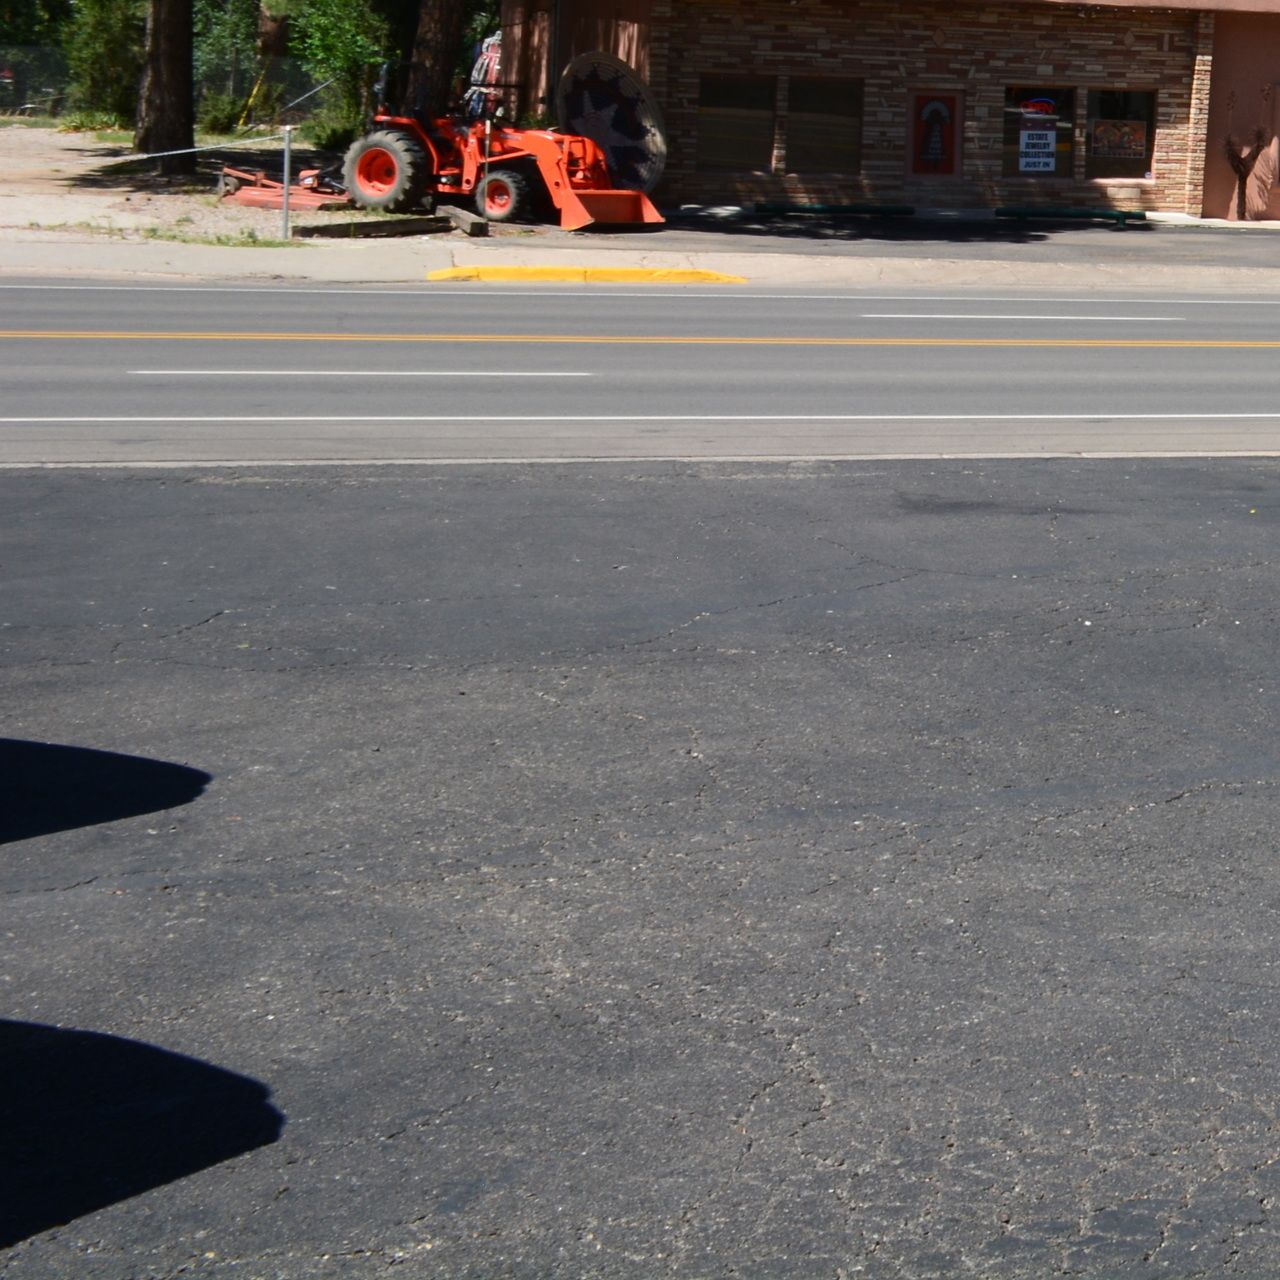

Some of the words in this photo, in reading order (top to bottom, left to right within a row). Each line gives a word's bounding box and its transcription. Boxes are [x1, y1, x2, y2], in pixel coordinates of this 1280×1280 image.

[1027, 132, 1048, 141] ESTATE
[1025, 141, 1051, 150] JEWELRY
[1020, 150, 1055, 159] COLLECTION
[1024, 160, 1041, 169] JUST
[1042, 160, 1051, 169] IN
